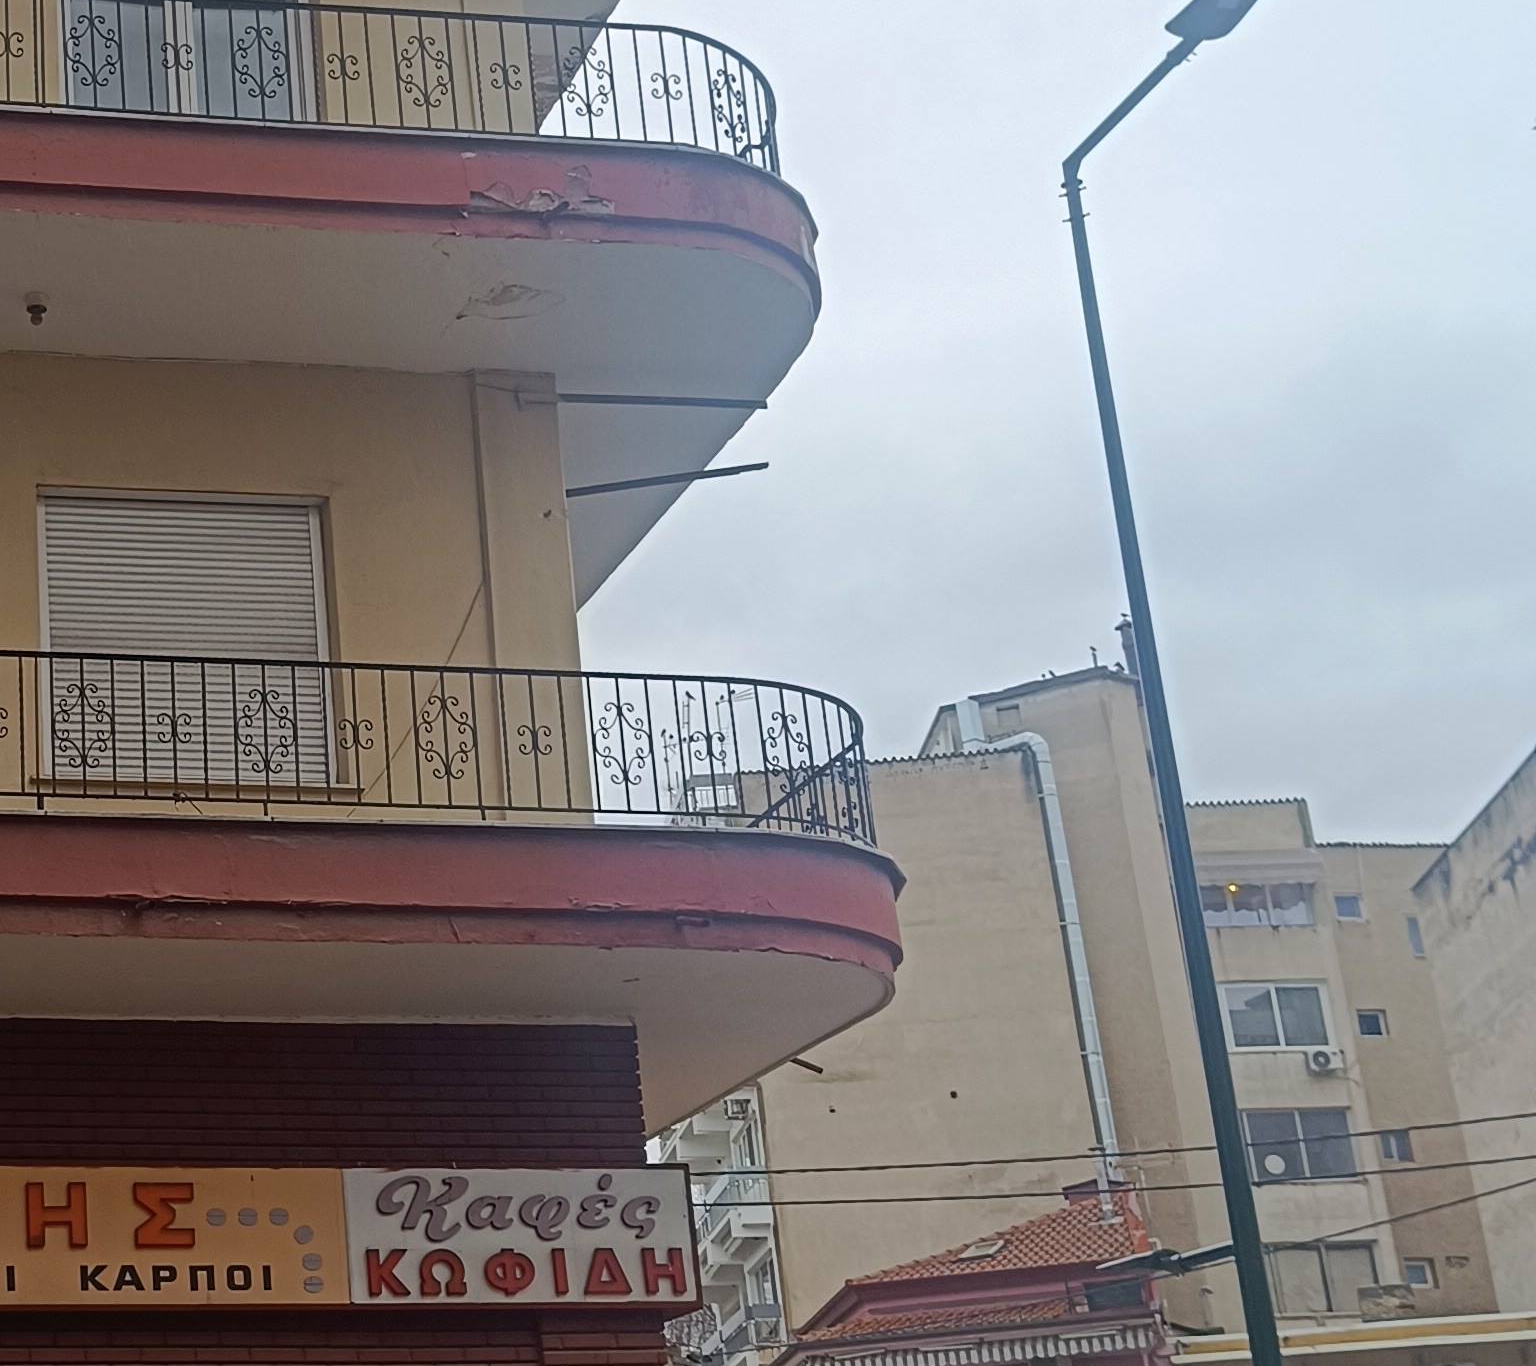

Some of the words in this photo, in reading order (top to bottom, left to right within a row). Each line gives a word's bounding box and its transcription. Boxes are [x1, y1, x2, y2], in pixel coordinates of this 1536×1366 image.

[376, 1173, 661, 1242] Καφές
[79, 1263, 272, 1292] ΚΑΡΠΟΙ
[366, 1247, 687, 1298] ΚΩΦΙΔΗ
